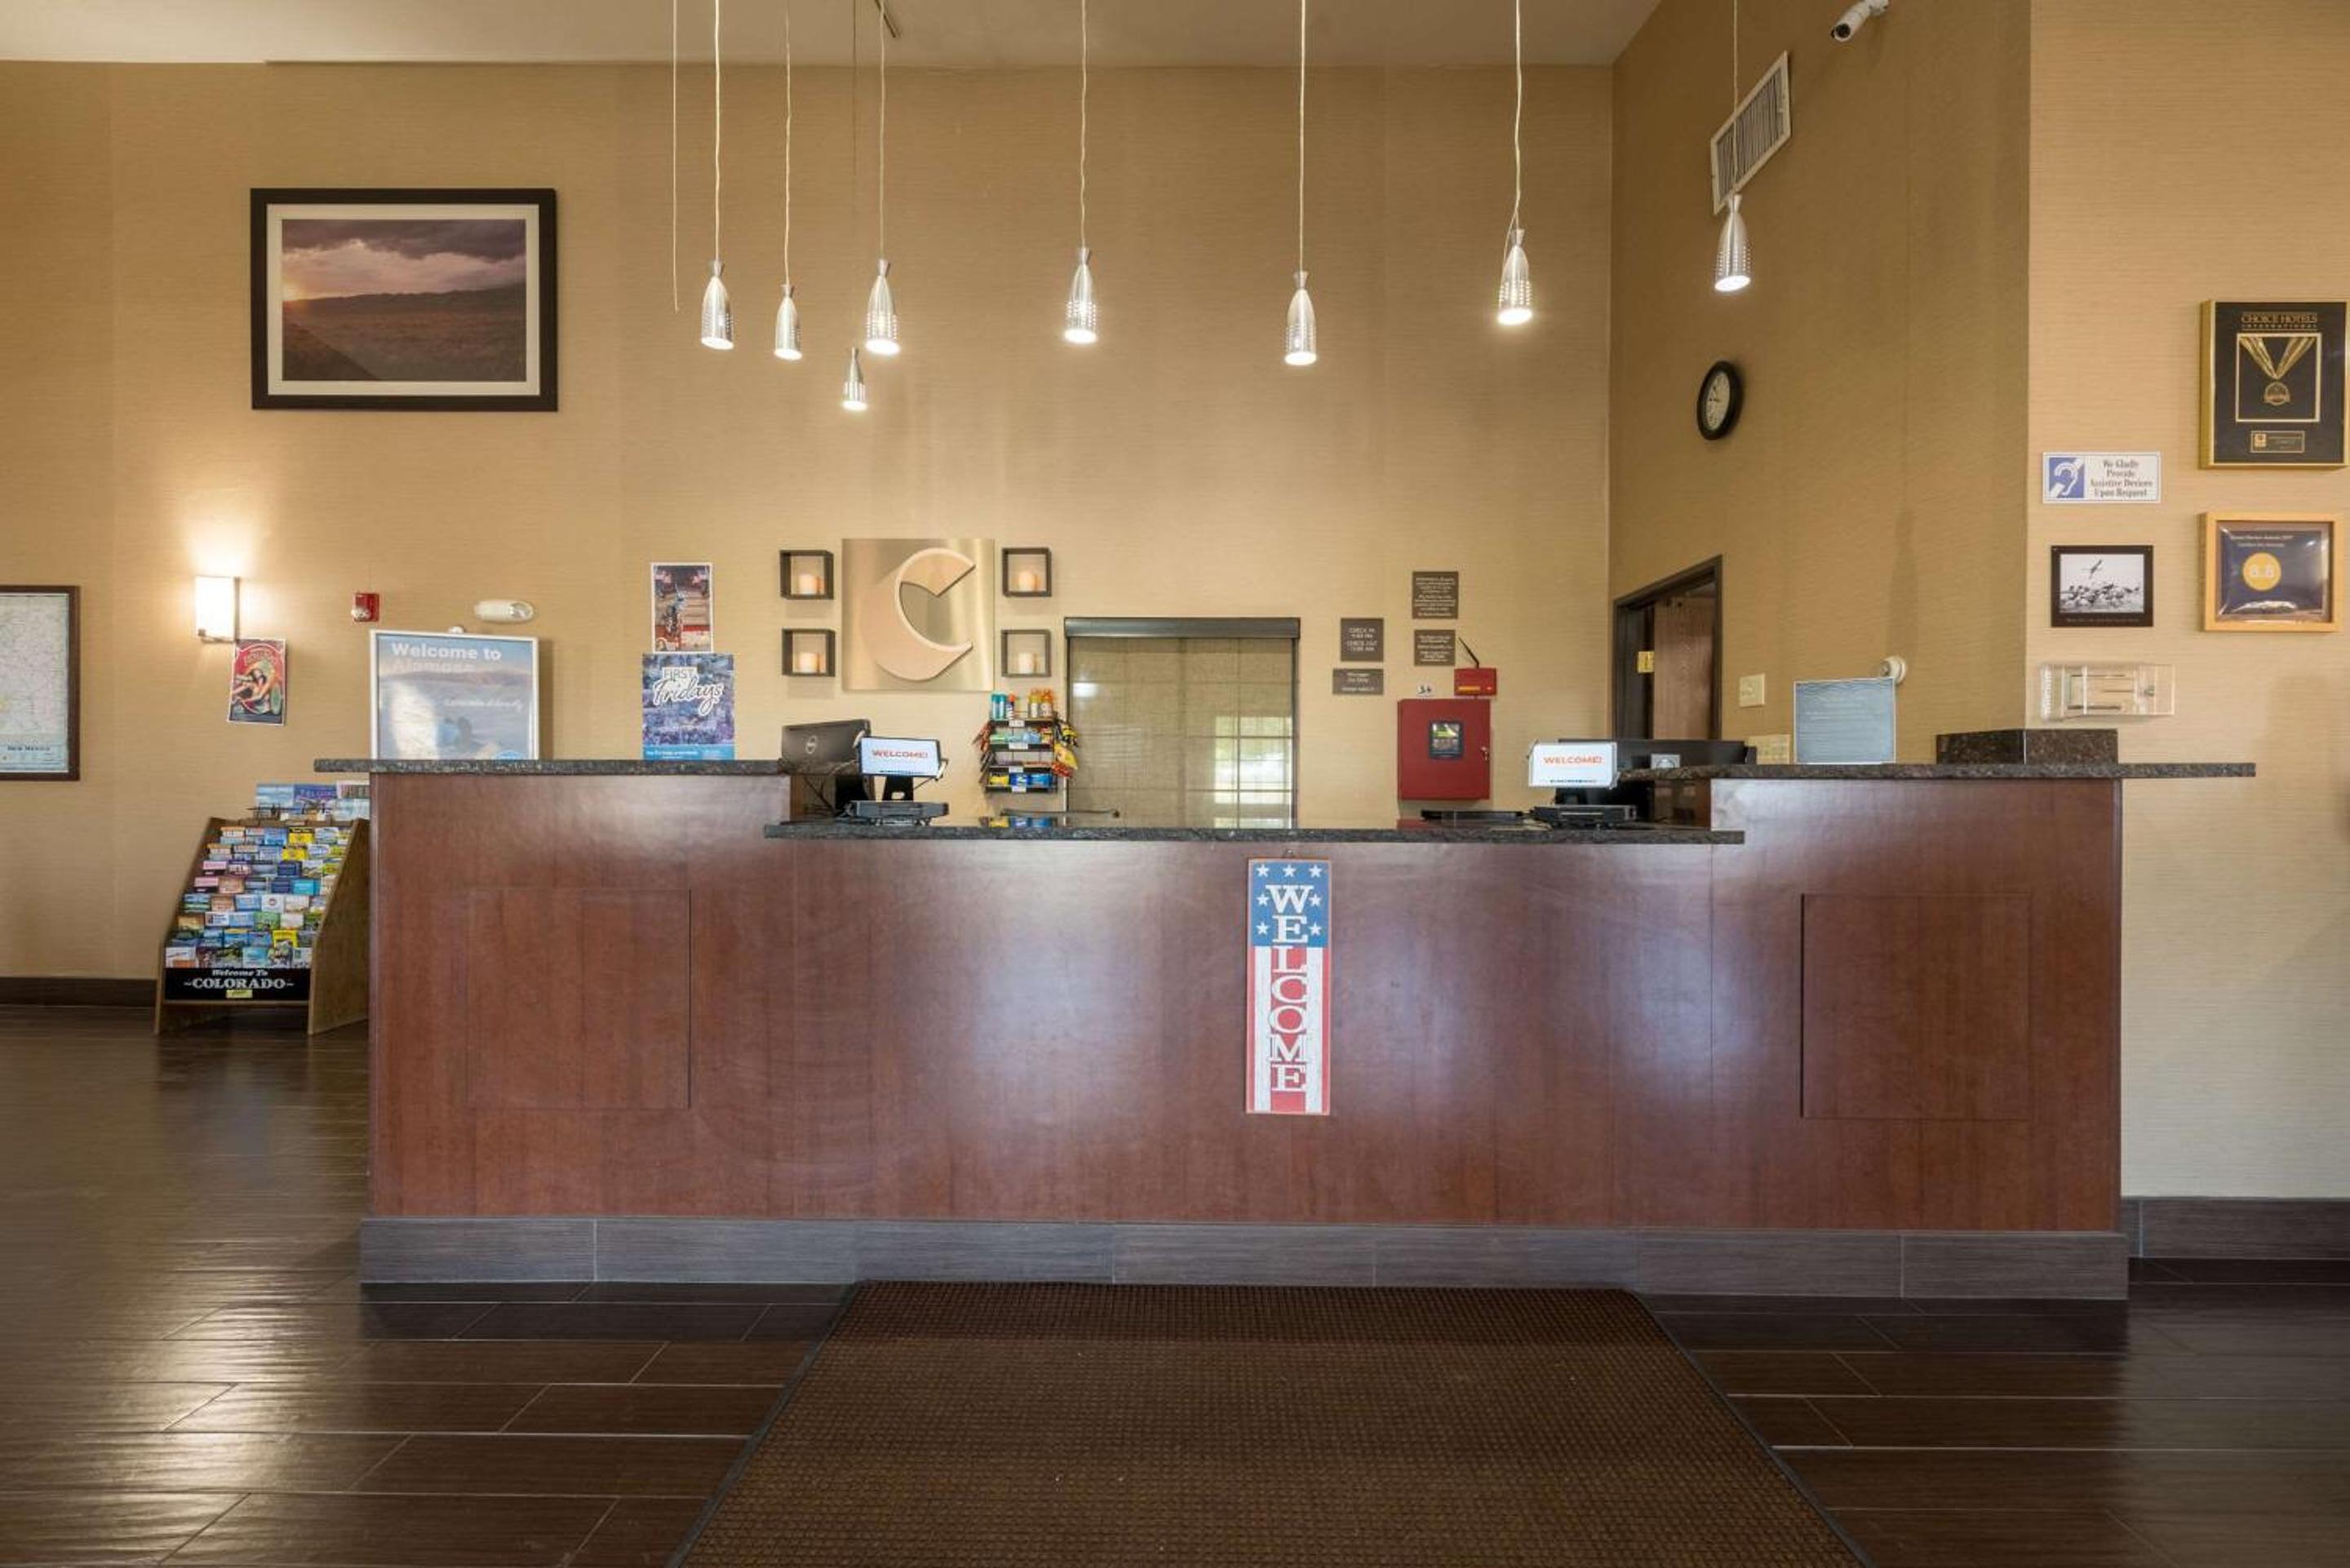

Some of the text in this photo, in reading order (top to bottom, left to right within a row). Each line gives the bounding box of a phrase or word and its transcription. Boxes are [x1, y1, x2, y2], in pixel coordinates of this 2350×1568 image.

[2091, 479, 2153, 487] Assistive Devices
[2117, 489, 2148, 498] Request
[392, 642, 502, 662] Welcome to
[663, 667, 697, 680] FIRST
[653, 673, 725, 716] Fridays
[871, 749, 929, 759] WELCOME!
[1543, 755, 1603, 764] WELCOME!
[212, 968, 268, 977] Welcome To
[1266, 884, 1314, 1092] WELCOME
